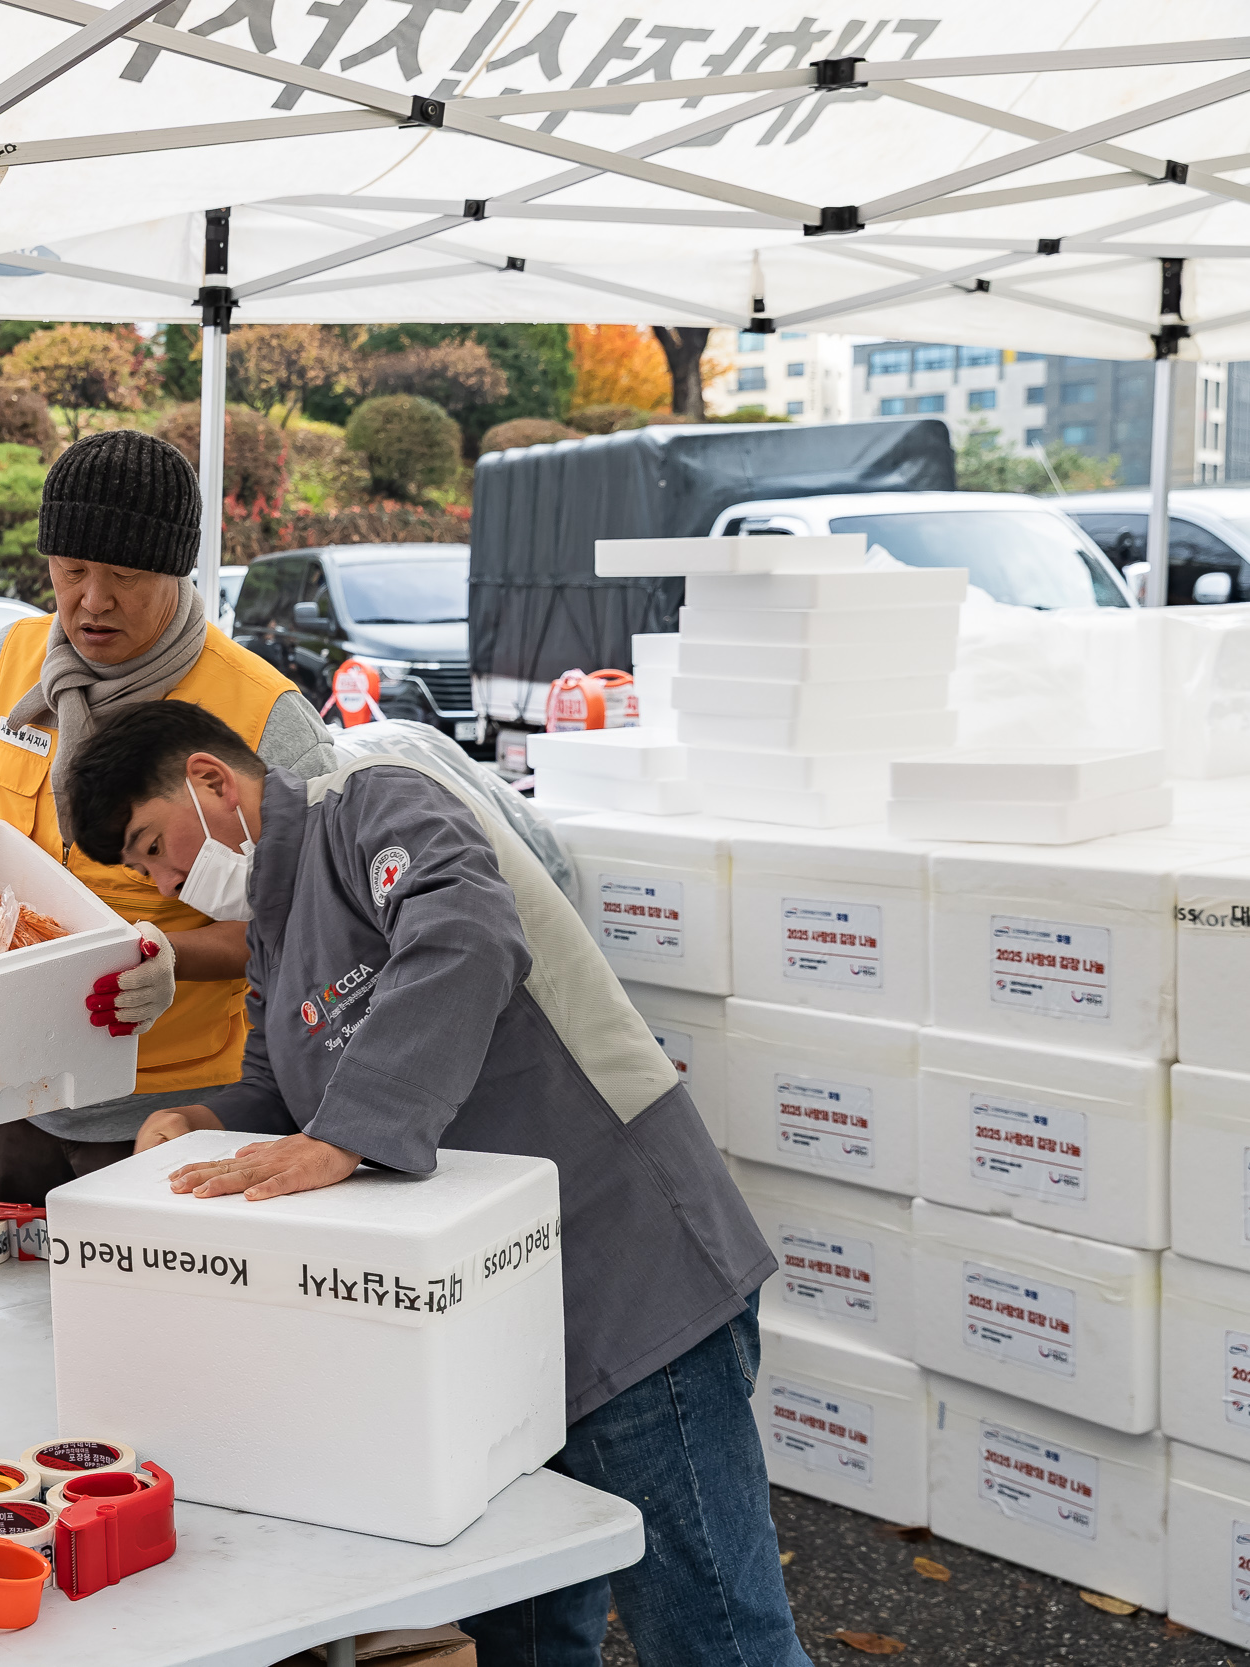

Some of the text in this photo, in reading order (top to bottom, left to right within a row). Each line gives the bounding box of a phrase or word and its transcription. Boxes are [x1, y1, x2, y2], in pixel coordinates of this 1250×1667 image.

[378, 853, 390, 866] RED
[996, 948, 1023, 963] 2025
[79, 1241, 134, 1273] Red
[142, 1247, 249, 1287] Korean
[484, 1222, 550, 1279] Red Cross
[298, 1263, 463, 1315] 대한적십자사
